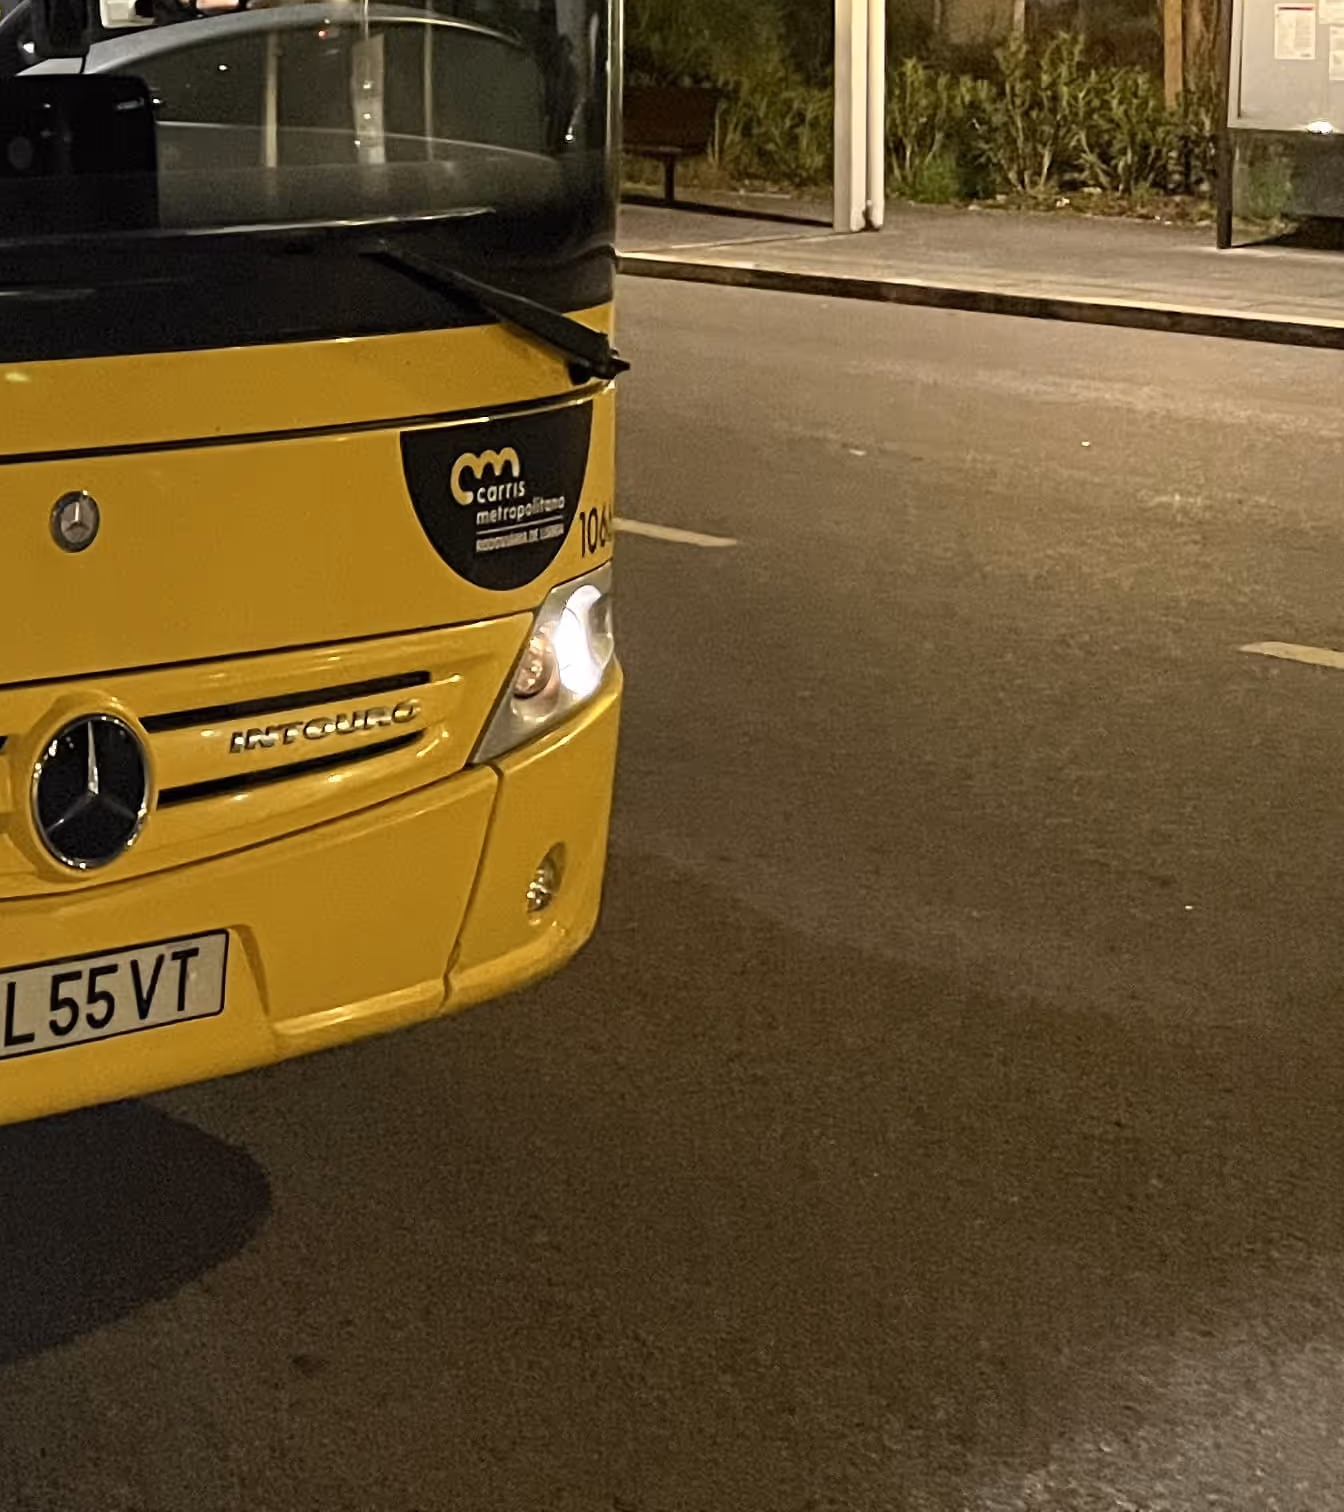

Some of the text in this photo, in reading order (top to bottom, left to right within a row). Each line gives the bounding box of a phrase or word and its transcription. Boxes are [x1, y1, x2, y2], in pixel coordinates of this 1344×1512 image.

[476, 496, 565, 526] metropolitana
[477, 480, 526, 504] carris
[229, 698, 422, 755] INTOURO
[49, 964, 119, 1037] 55
[129, 947, 200, 1020] VT
